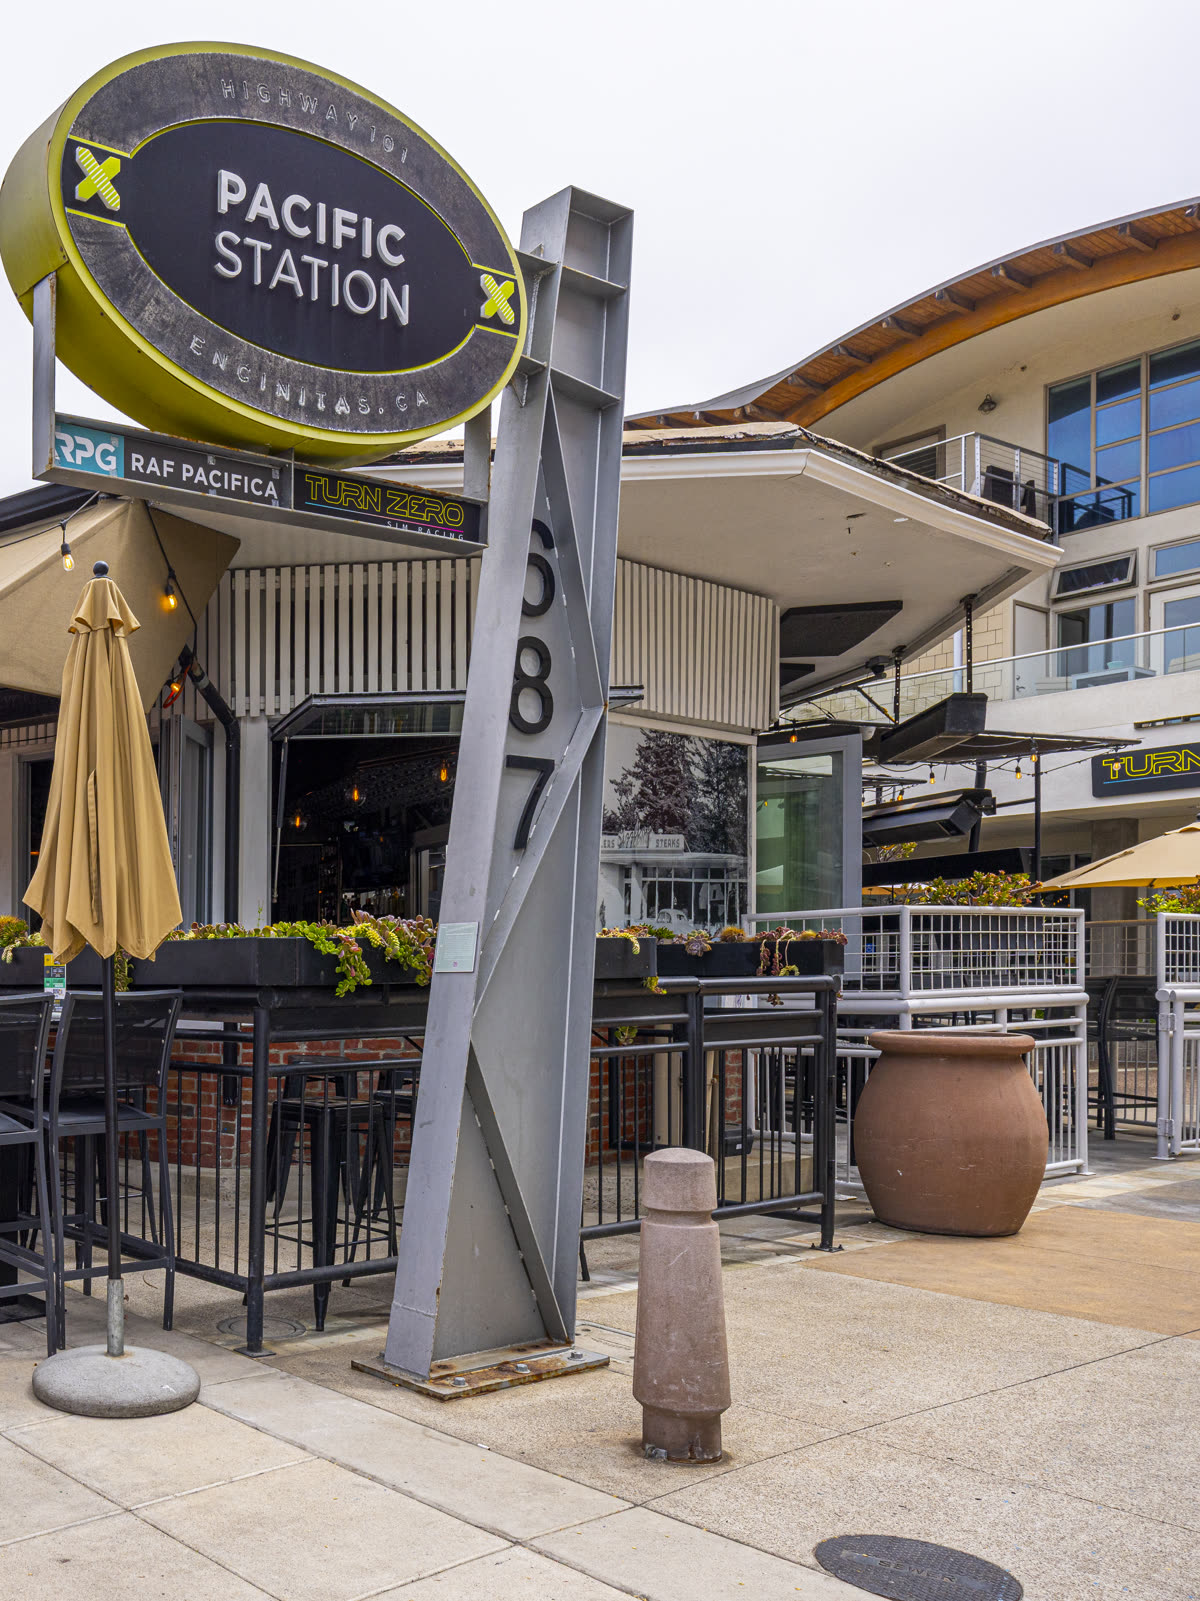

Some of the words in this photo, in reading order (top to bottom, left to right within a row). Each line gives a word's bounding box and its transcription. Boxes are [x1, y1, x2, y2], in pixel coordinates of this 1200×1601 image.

[220, 78, 358, 132] HIGHWAY
[370, 125, 408, 164] 101
[217, 169, 406, 267] PACIFIC
[214, 230, 410, 326] STATION
[55, 431, 117, 472] RPG
[131, 452, 175, 478] RAF
[182, 463, 279, 500] PACIFICA
[305, 473, 381, 512] TURN
[386, 490, 465, 527] ZERO
[387, 520, 409, 531] SIM
[417, 526, 465, 541] RACING
[1102, 749, 1200, 780] TURN
[601, 839, 615, 848] ERS
[655, 838, 680, 849] STEAKS
[878, 1560, 957, 1584] SEWER
